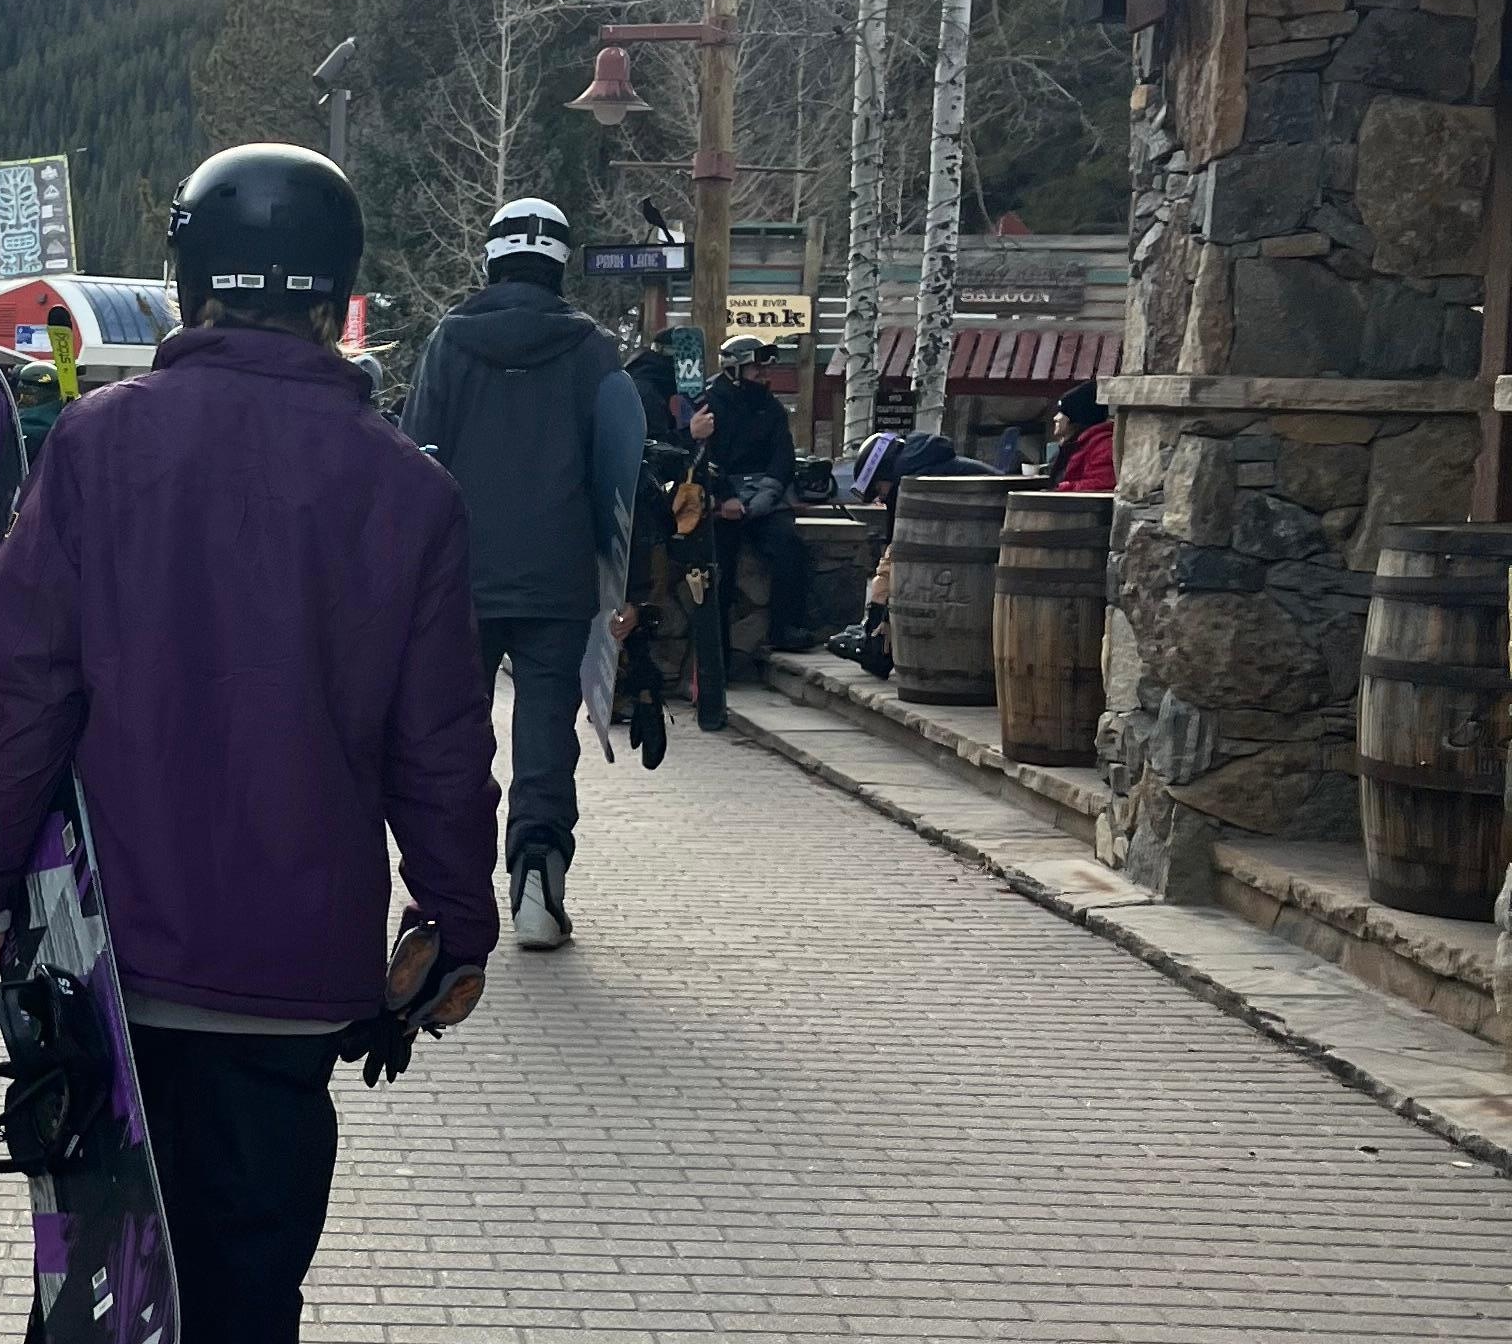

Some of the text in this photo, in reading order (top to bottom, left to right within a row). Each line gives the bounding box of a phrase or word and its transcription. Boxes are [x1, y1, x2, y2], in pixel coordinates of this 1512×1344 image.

[960, 287, 1050, 303] SALOON
[729, 299, 788, 307] SNAKE RIVER
